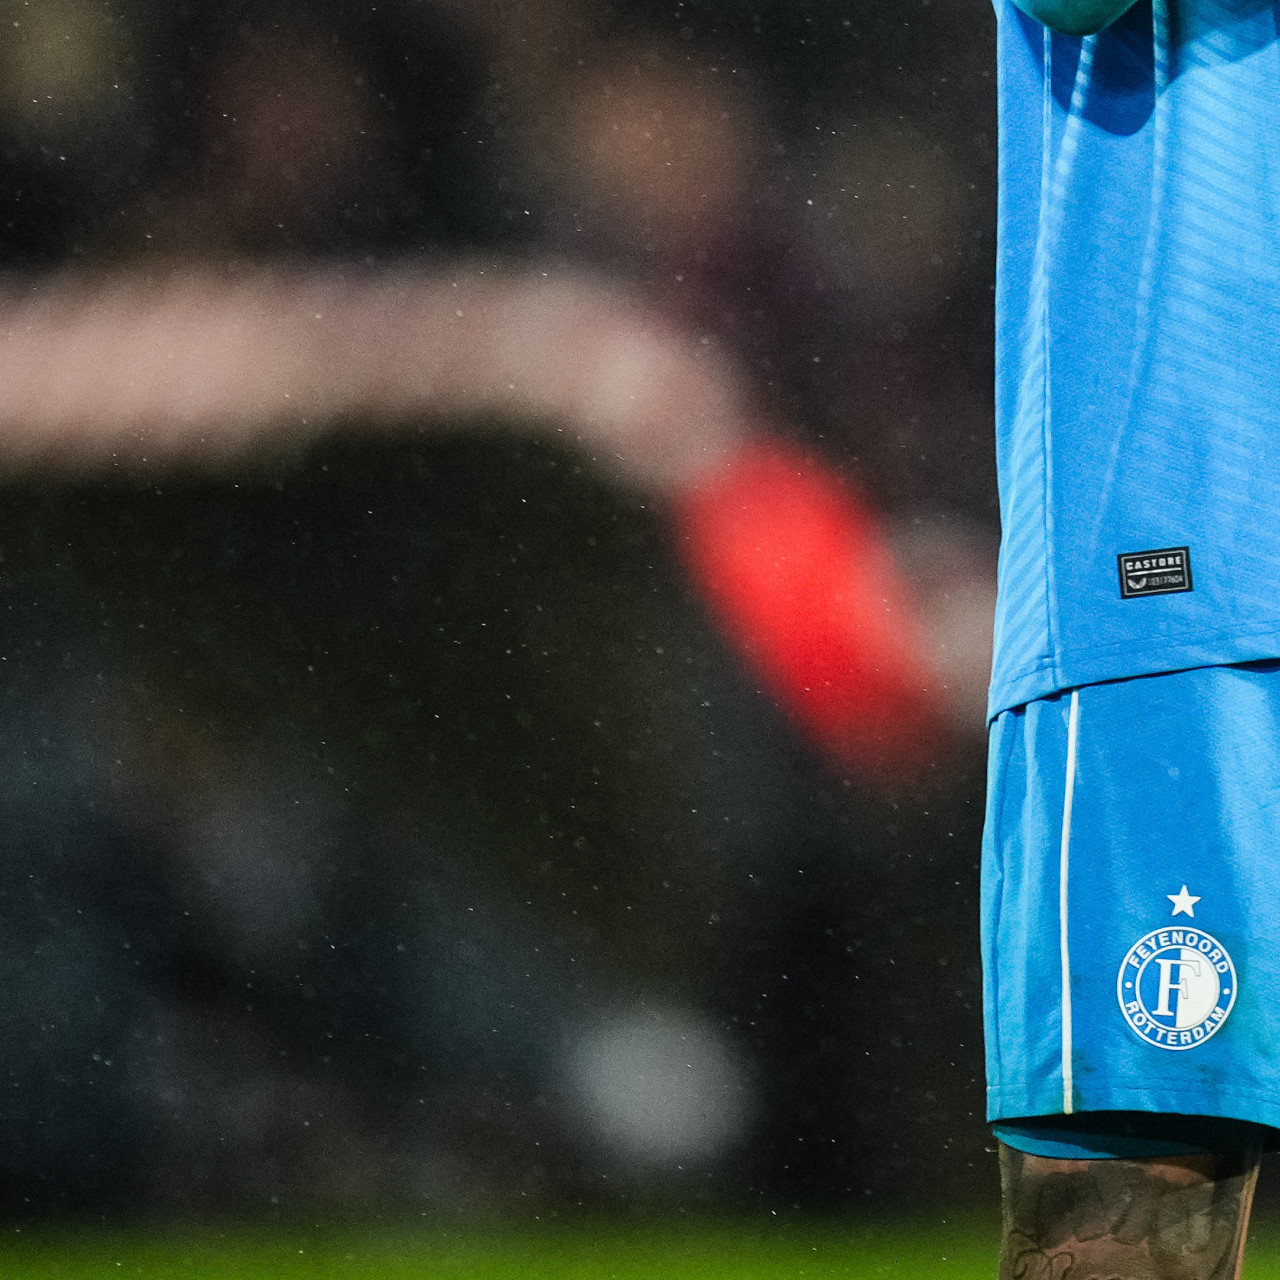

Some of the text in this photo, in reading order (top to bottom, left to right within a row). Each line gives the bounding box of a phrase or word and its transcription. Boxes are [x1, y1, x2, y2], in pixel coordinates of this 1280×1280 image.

[1126, 556, 1182, 570] CASTORE
[1128, 931, 1230, 973] FEYENOORD
[1125, 1000, 1226, 1045] ROTTERDAM
